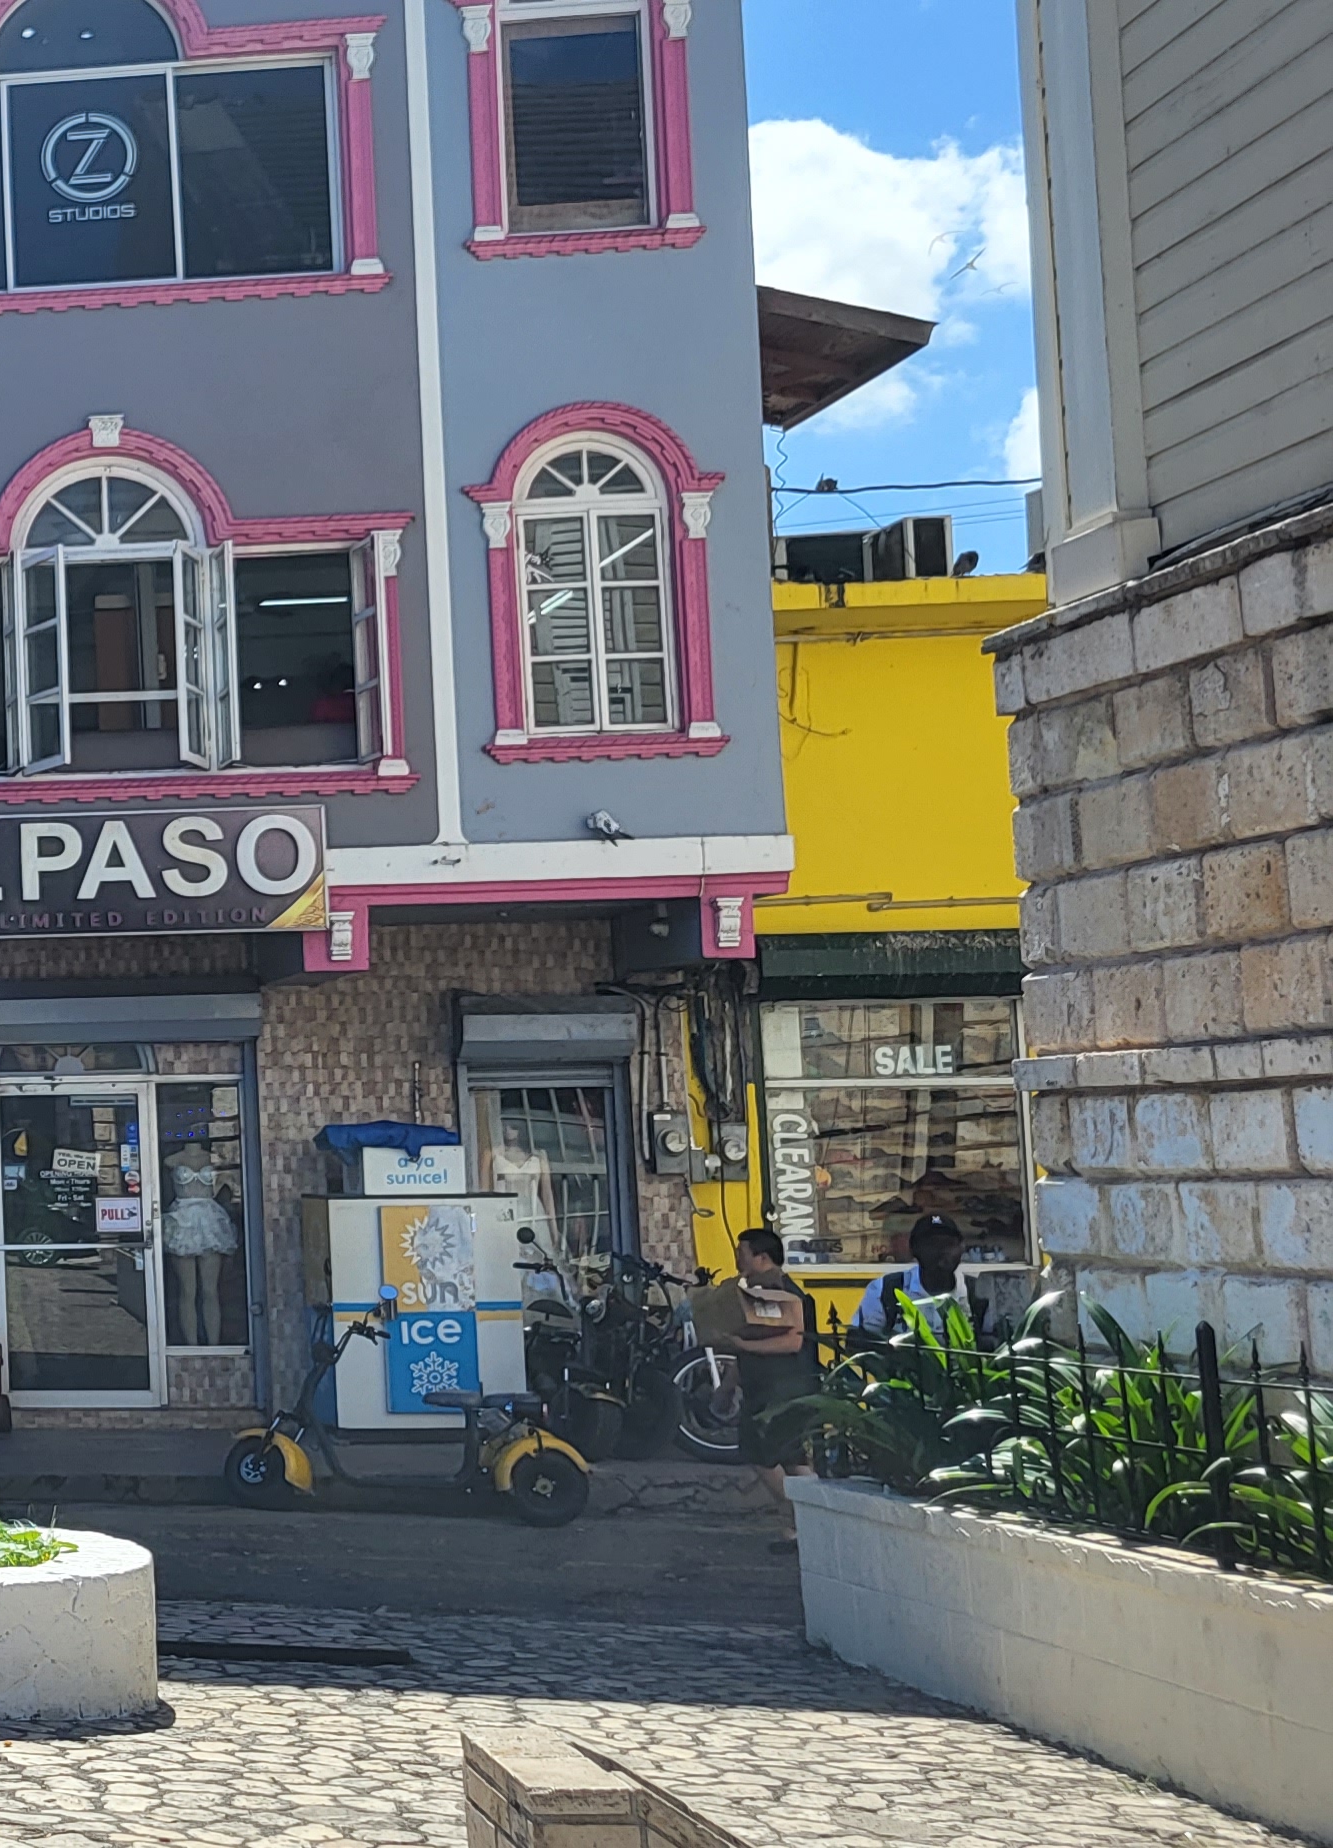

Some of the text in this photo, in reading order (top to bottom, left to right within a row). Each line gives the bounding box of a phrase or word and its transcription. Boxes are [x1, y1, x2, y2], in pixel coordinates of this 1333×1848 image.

[48, 203, 137, 223] STUDIOS
[19, 814, 317, 902] PASO
[0, 911, 123, 931] LIMITED
[145, 906, 268, 926] EDITION
[874, 1045, 953, 1076] SALE
[57, 1158, 97, 1171] OPEN
[386, 1168, 448, 1185] sunice!
[100, 1208, 126, 1221] PULL
